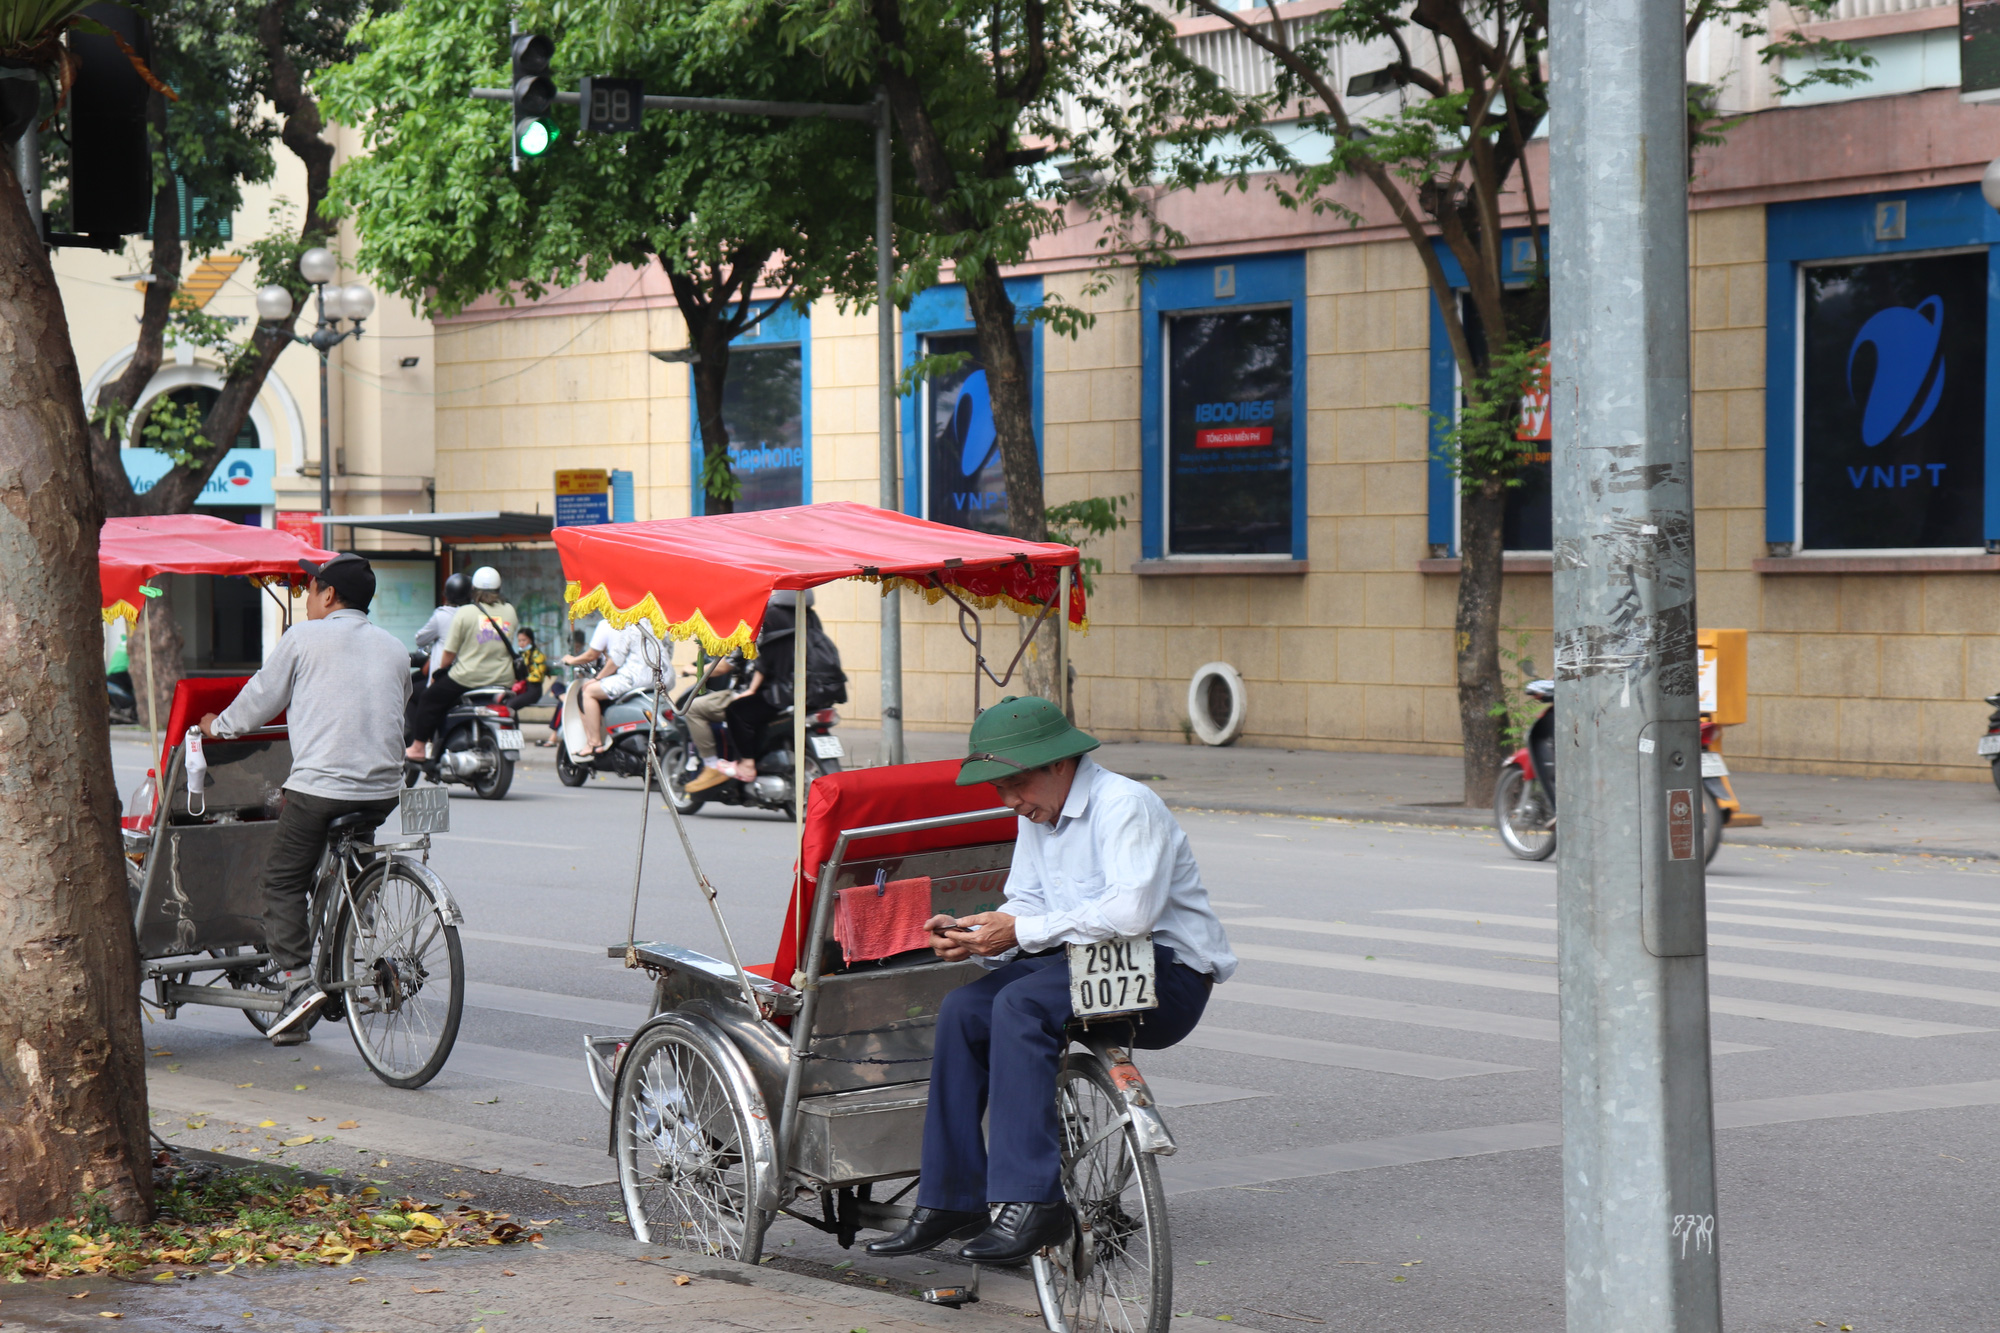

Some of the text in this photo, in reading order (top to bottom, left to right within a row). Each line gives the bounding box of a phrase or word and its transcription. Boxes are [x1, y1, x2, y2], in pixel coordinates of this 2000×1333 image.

[1846, 463, 1947, 489] VNPT
[1086, 940, 1139, 975] 29XL
[1080, 974, 1148, 1010] 0072
